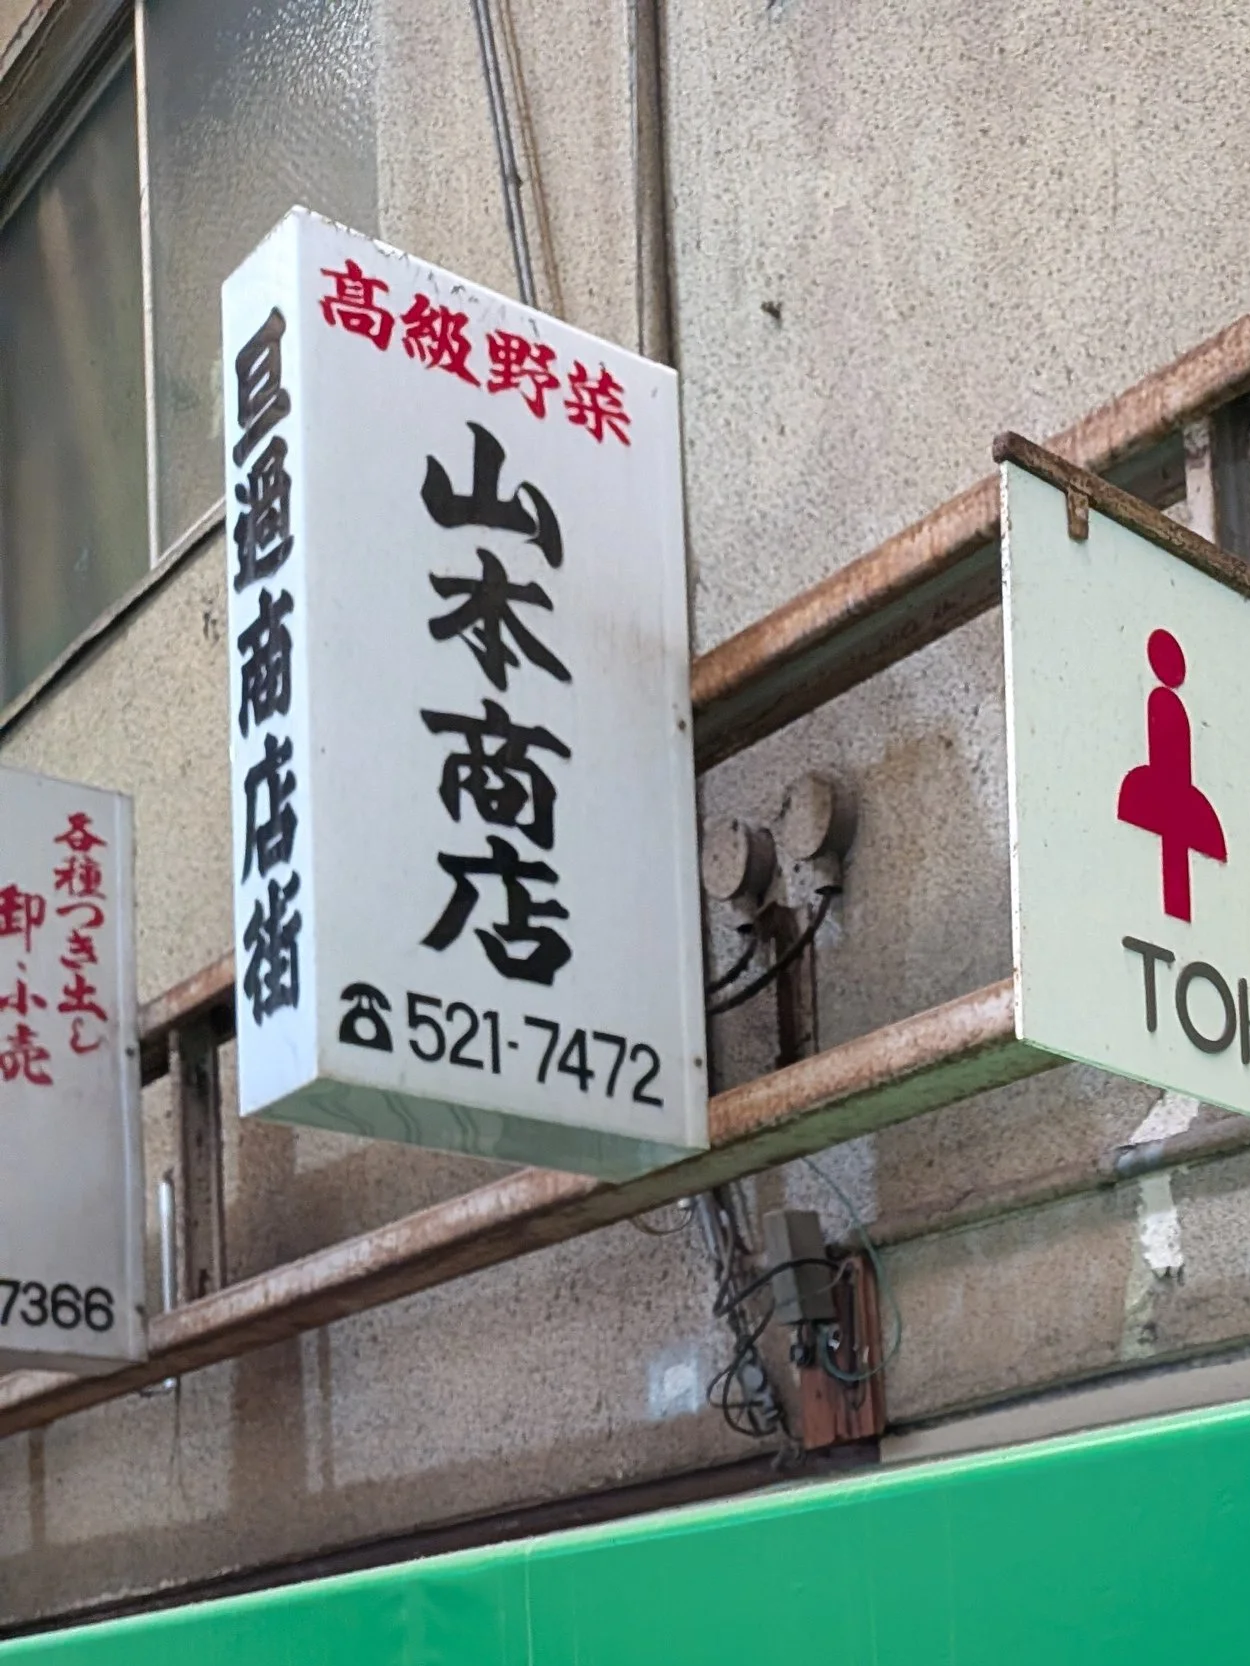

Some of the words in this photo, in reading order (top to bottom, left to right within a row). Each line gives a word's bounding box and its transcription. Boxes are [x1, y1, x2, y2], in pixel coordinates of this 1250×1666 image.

[318, 258, 631, 447] 高級野菜
[233, 305, 302, 1026] 旦過商店街
[420, 420, 573, 987] 山本商店
[53, 811, 107, 1055] 各種つき出し
[406, 990, 665, 1108] 521-7472
[0, 1280, 114, 1332] 7366
